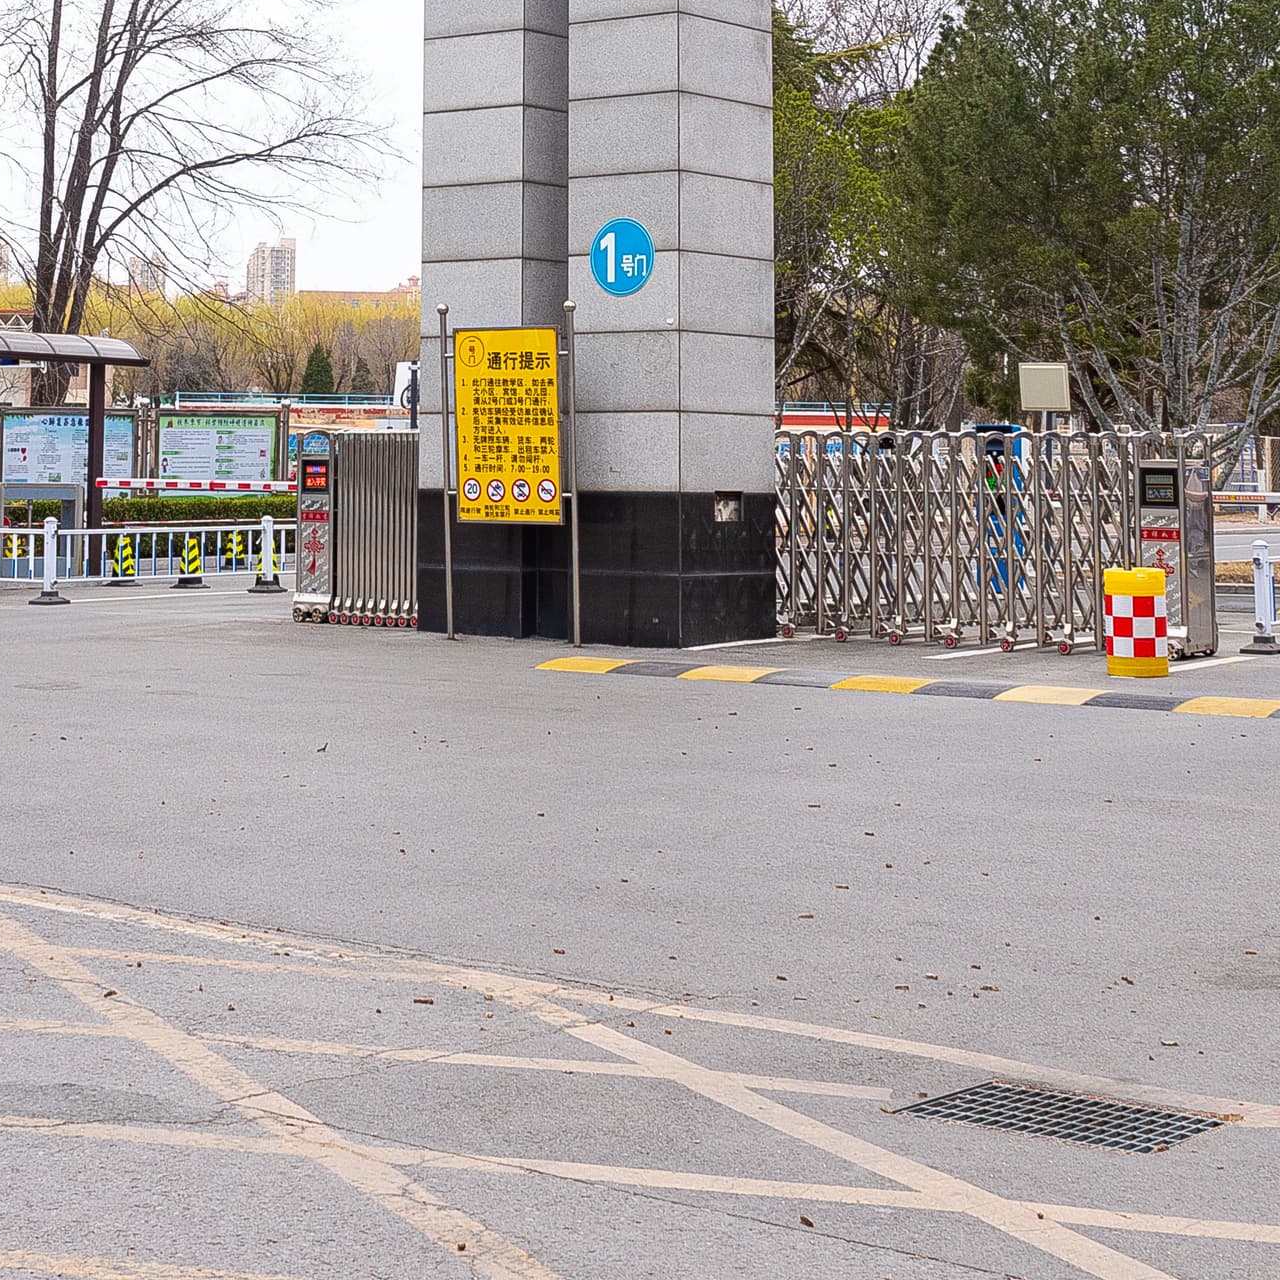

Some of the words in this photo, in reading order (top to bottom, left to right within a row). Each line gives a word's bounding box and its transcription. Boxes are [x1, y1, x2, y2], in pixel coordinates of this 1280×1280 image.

[599, 231, 647, 284] 1号门
[487, 351, 551, 371] 通行提示
[467, 483, 478, 495] 20
